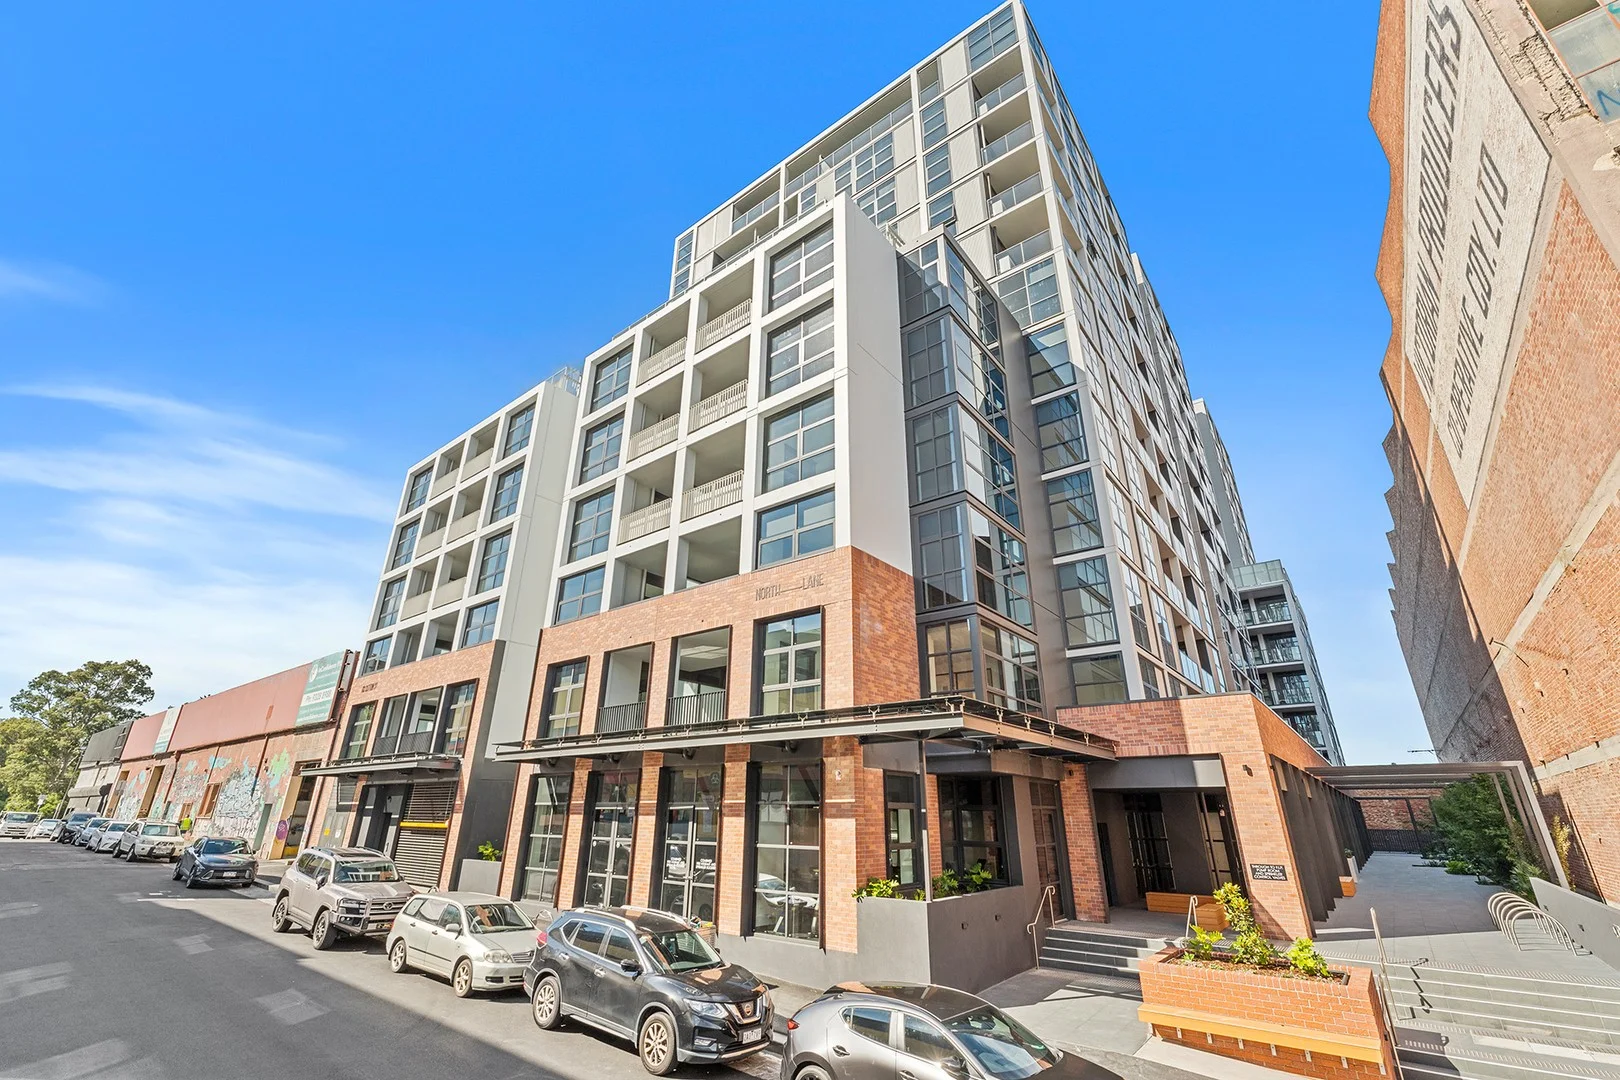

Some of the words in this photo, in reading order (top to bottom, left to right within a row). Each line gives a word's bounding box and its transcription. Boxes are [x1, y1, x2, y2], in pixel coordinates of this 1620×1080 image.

[1418, 0, 1461, 283] PRODUCERS
[1474, 141, 1509, 249] LTD
[1413, 250, 1440, 402] VICTORIAN
[755, 584, 780, 601] NORTH
[802, 573, 824, 590] LANE
